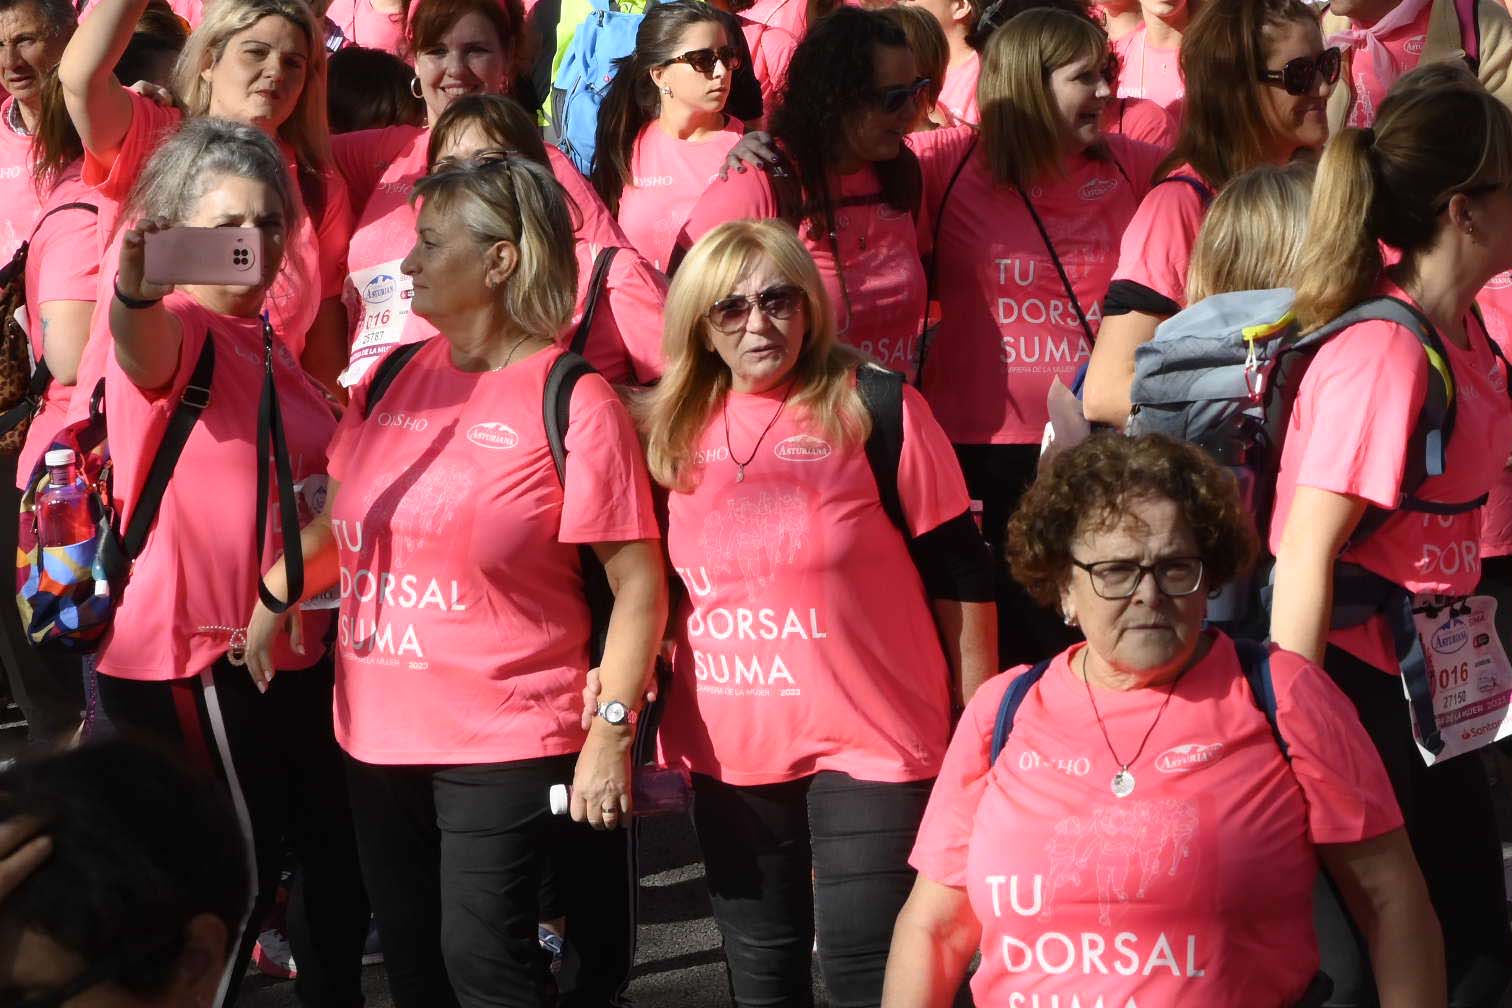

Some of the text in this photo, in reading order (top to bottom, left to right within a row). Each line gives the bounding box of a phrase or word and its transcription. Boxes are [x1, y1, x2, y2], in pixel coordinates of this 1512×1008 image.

[994, 258, 1035, 287] TU
[998, 298, 1102, 327] DORSA
[331, 519, 364, 553] TU
[340, 567, 467, 612] DORSAL
[341, 615, 424, 658] SUMA
[688, 607, 828, 641] DORSAL
[694, 648, 796, 686] SUMA
[985, 874, 1043, 918] TU
[1001, 931, 1206, 978] DORSAL
